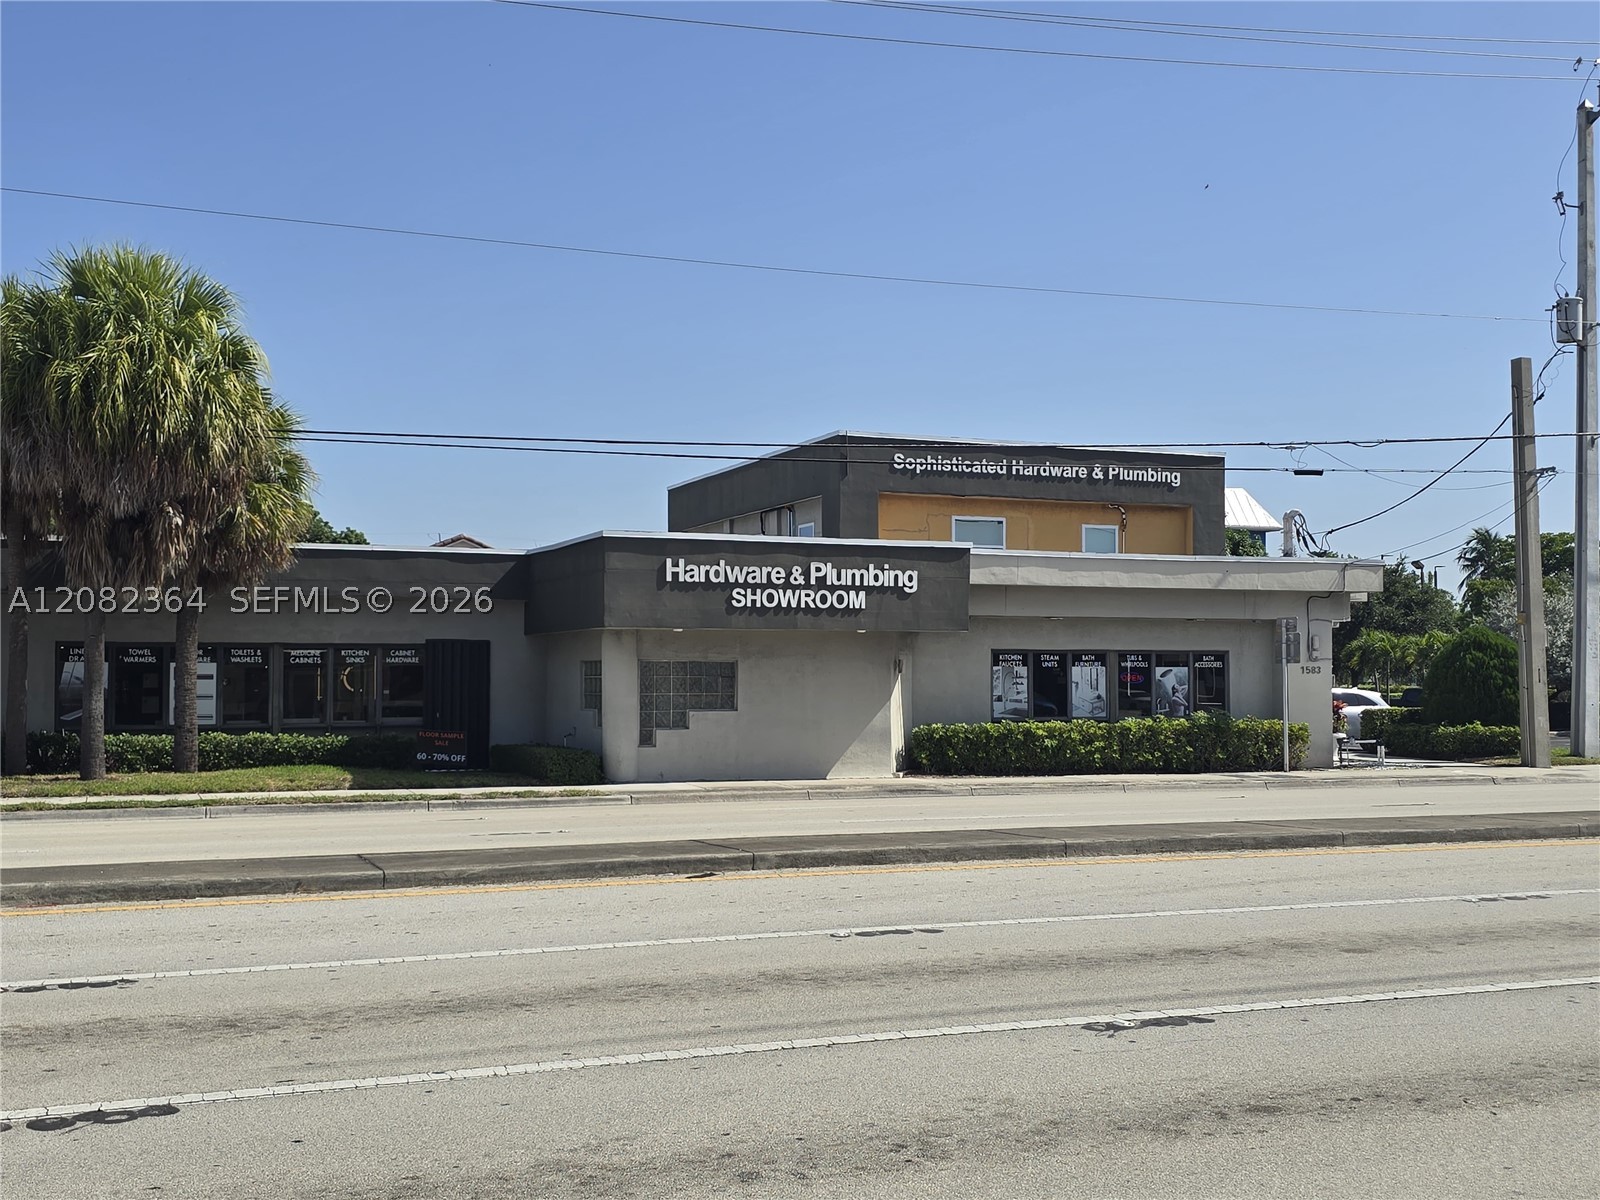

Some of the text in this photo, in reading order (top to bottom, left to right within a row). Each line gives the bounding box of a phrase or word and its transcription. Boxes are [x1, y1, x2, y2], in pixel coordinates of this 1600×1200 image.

[893, 453, 1181, 486] Sophisticated Hardware & Plumbing
[665, 558, 918, 593] Hardware & Plumbing
[731, 588, 866, 609] SHOWROOM
[1300, 666, 1321, 674] 1583
[416, 752, 427, 760] 60
[432, 753, 449, 761] 70%
[450, 754, 466, 762] OFF
